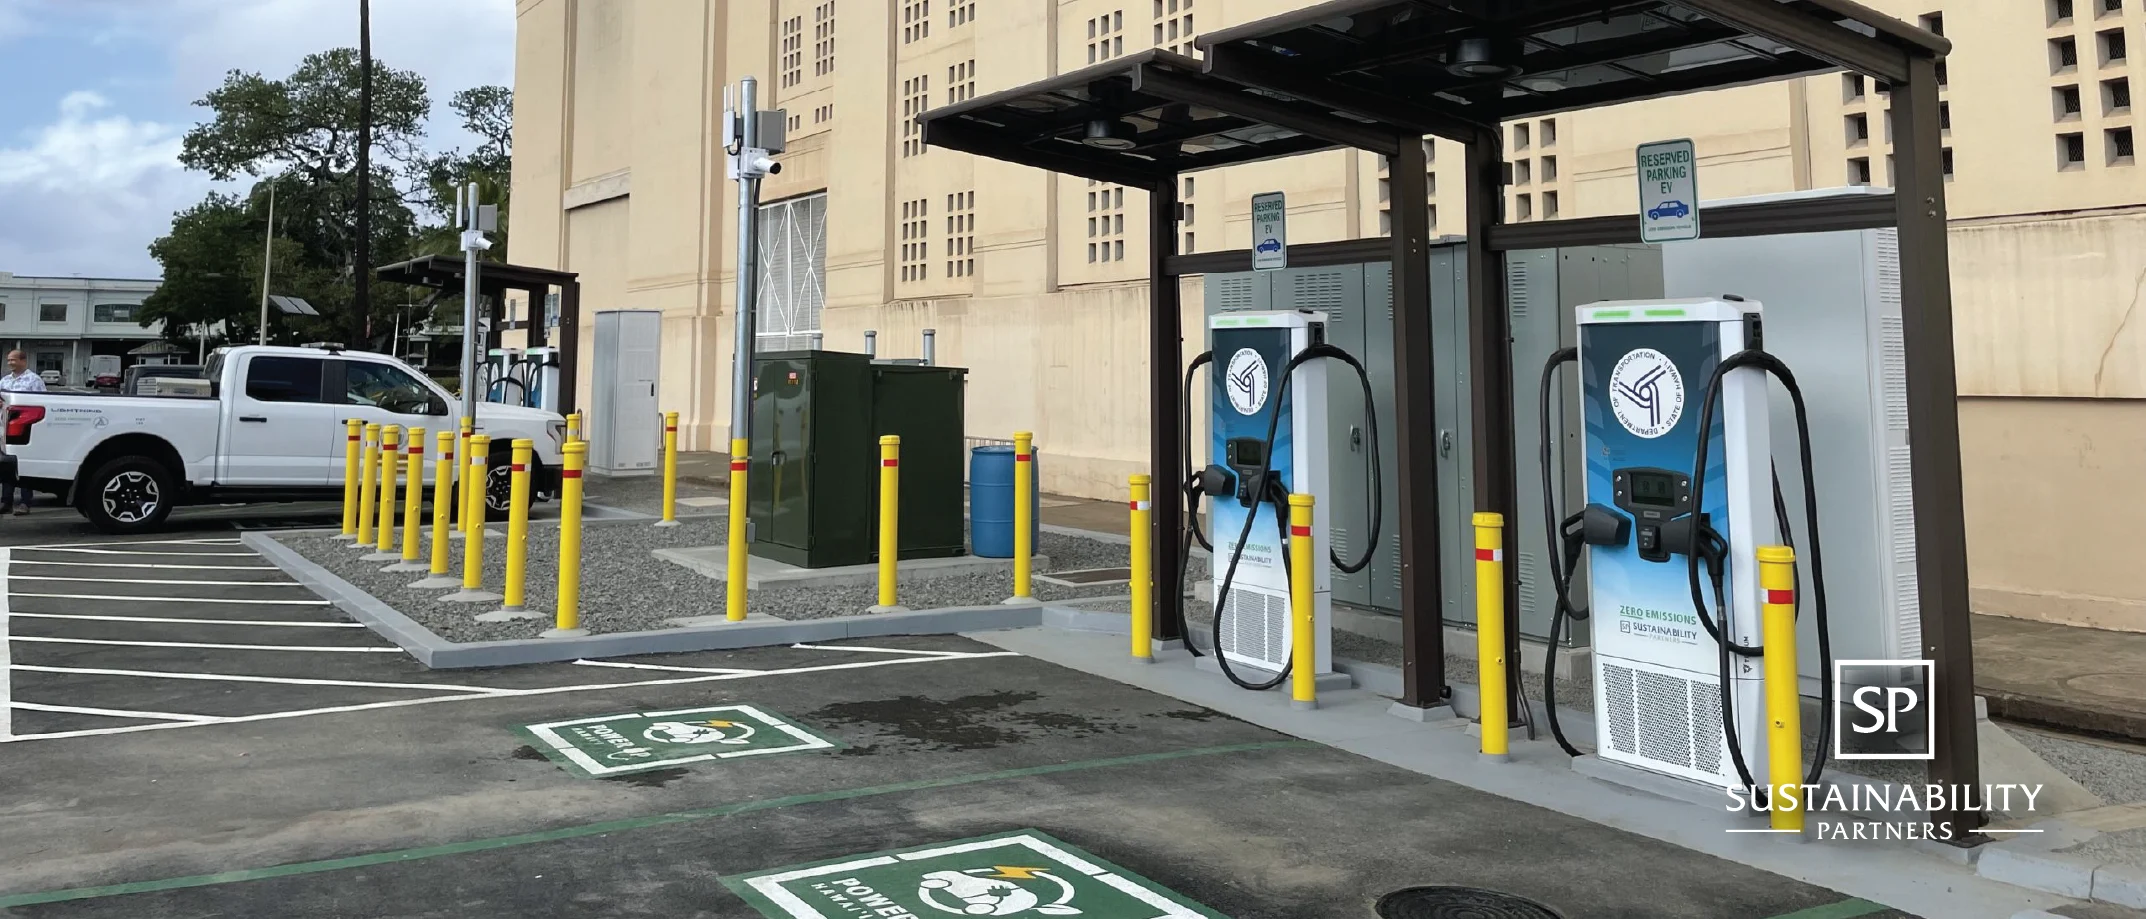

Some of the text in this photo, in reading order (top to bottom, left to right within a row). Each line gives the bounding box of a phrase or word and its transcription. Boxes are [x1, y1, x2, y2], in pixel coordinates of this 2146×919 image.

[1641, 150, 1690, 168] RESERVED
[1646, 166, 1687, 182] PARKING
[1660, 181, 1672, 194] EV
[1254, 201, 1282, 212] RESERVED
[1257, 212, 1280, 223] PARKING
[1265, 224, 1273, 234] EV
[1612, 351, 1659, 436] DEPARTMENT OF TRANSPORTATION
[1665, 405, 1681, 427] STATE
[1675, 393, 1682, 402] OF
[1240, 554, 1272, 564] STAINABILITY
[1620, 605, 1697, 625] ZERO EMISSIONS
[1633, 622, 1697, 640] SUSTAINABILITY
[586, 724, 635, 748] POWER
